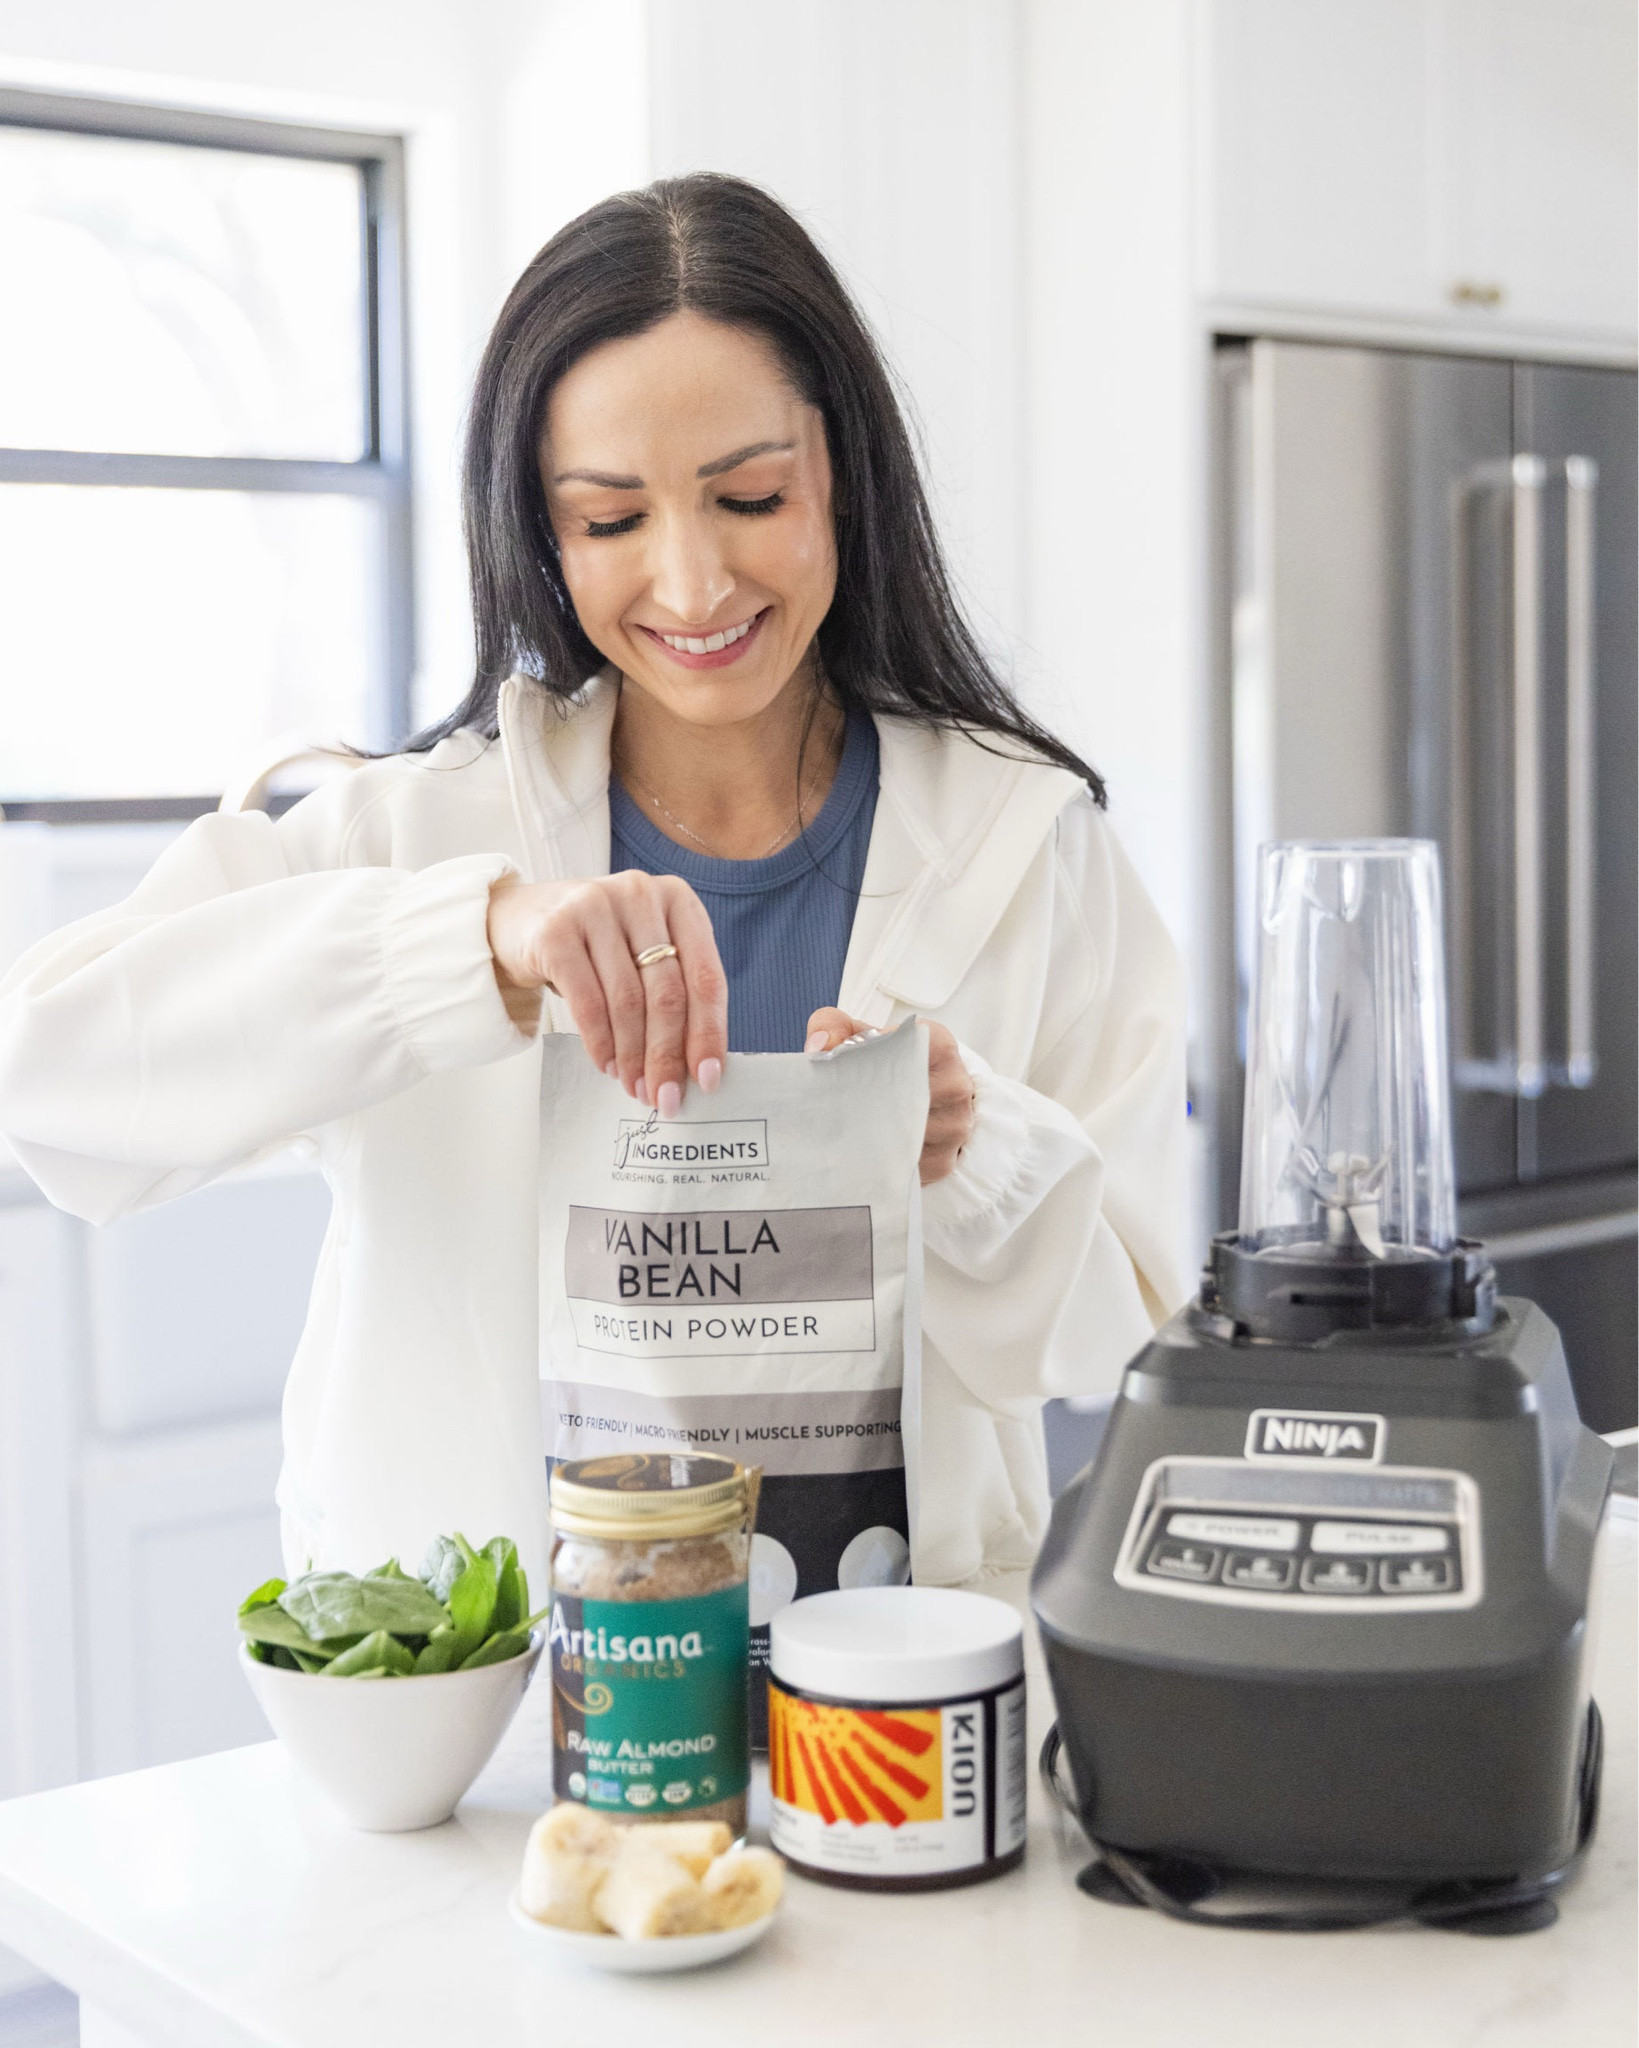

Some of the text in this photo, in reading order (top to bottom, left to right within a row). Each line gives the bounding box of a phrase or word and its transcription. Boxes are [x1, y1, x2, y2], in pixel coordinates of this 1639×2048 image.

[615, 1108, 659, 1169] just
[632, 1142, 758, 1161] INGREDIENTS
[611, 1171, 770, 1184] NOURISHING. REAL. NATURAL.
[604, 1218, 780, 1256] VANILLA
[618, 1262, 741, 1298] BEAN
[594, 1315, 819, 1341] PROTEIN POWDER
[586, 1416, 628, 1433] FRIENDLY
[635, 1424, 666, 1438] MACRO
[667, 1428, 731, 1442] FRIENDLY
[745, 1426, 810, 1441] MUSCLE
[814, 1420, 902, 1438] SUPPORTING
[1262, 1416, 1366, 1456] NINJA
[550, 1600, 704, 1662] Artisana
